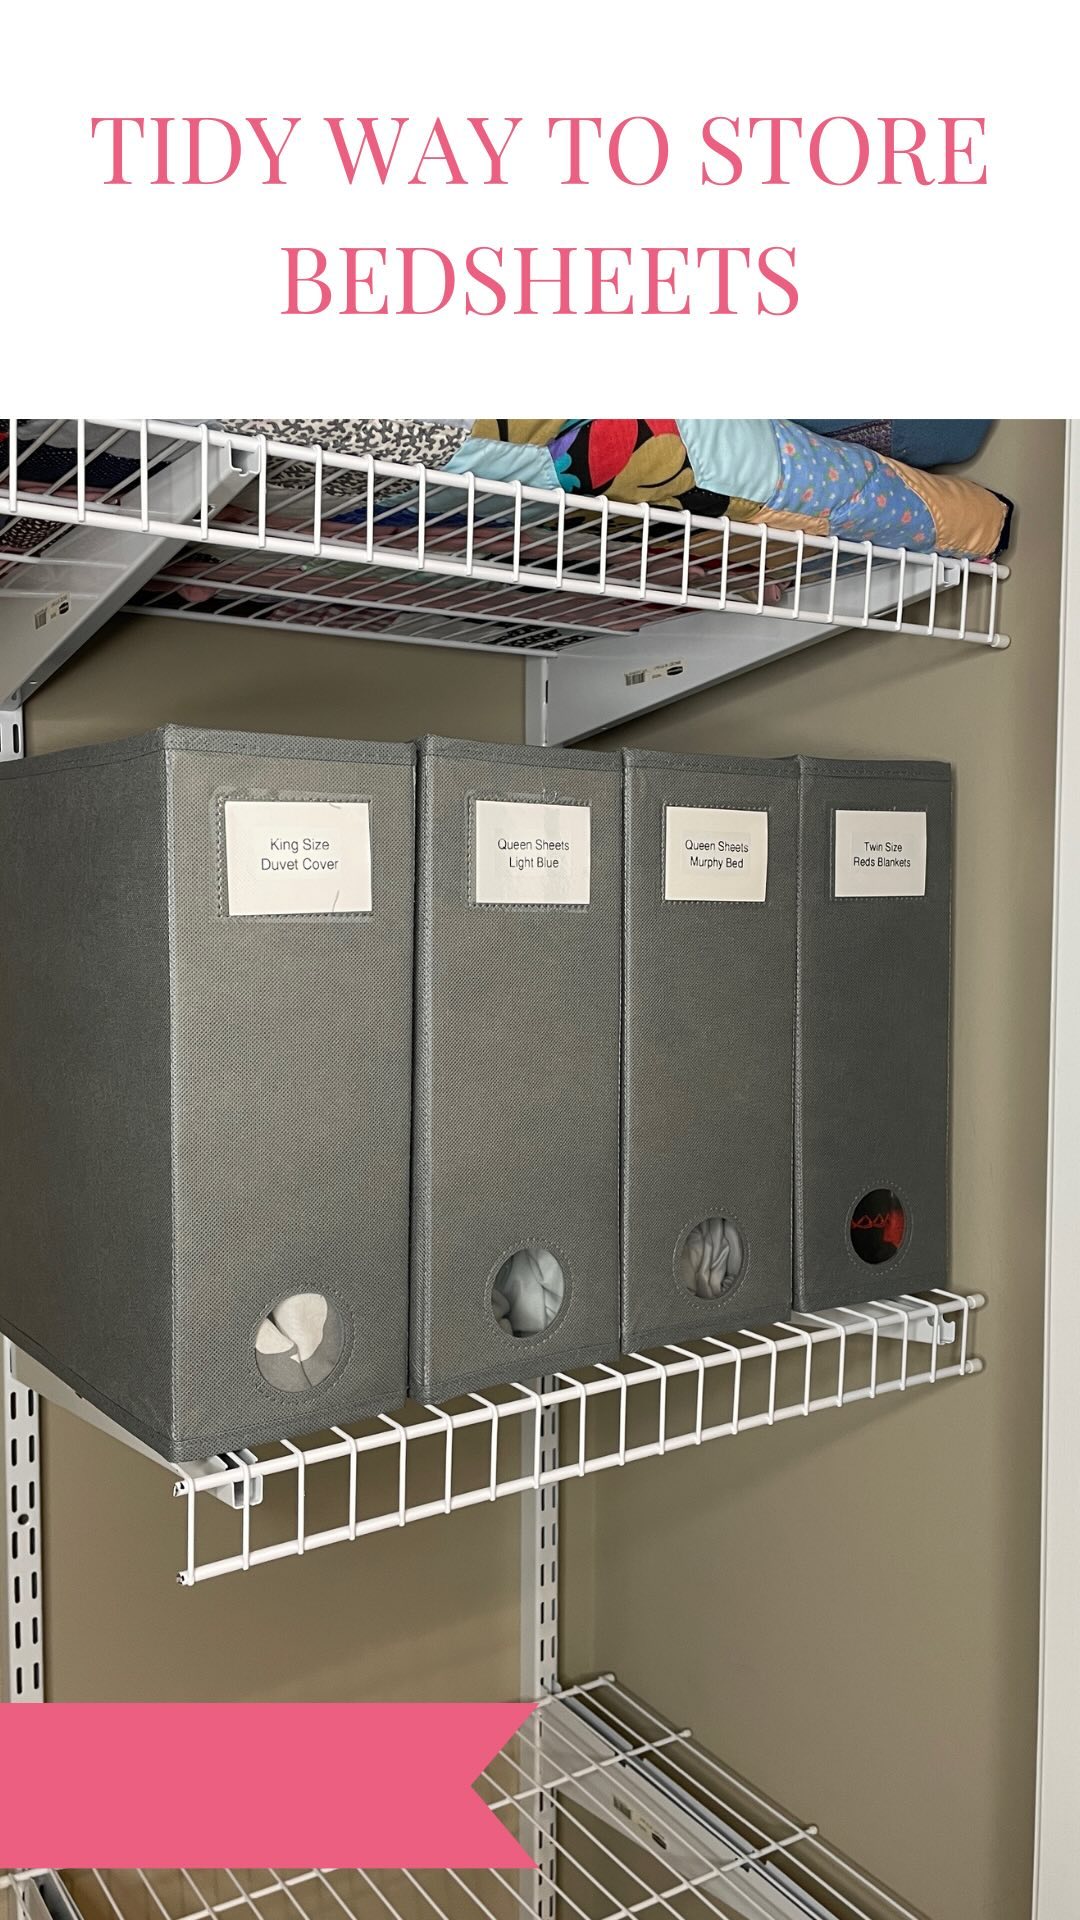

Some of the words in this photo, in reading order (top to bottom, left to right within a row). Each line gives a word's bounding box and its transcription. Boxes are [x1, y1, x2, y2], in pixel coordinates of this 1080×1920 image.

[270, 838, 299, 853] King
[303, 838, 330, 850] Size
[497, 838, 532, 850] Queen
[535, 839, 570, 851] Sheets
[685, 839, 715, 851] Queen
[718, 841, 749, 853] Sheets
[864, 841, 883, 852] Twin
[885, 841, 903, 853] Size
[261, 858, 298, 871] Duvet
[302, 857, 339, 870] Cover
[509, 857, 534, 870] Light
[537, 857, 559, 868] Blue
[690, 856, 723, 870] Murphy
[726, 858, 744, 869] Bed
[853, 857, 875, 867] Reds
[877, 857, 911, 868] Blankets
